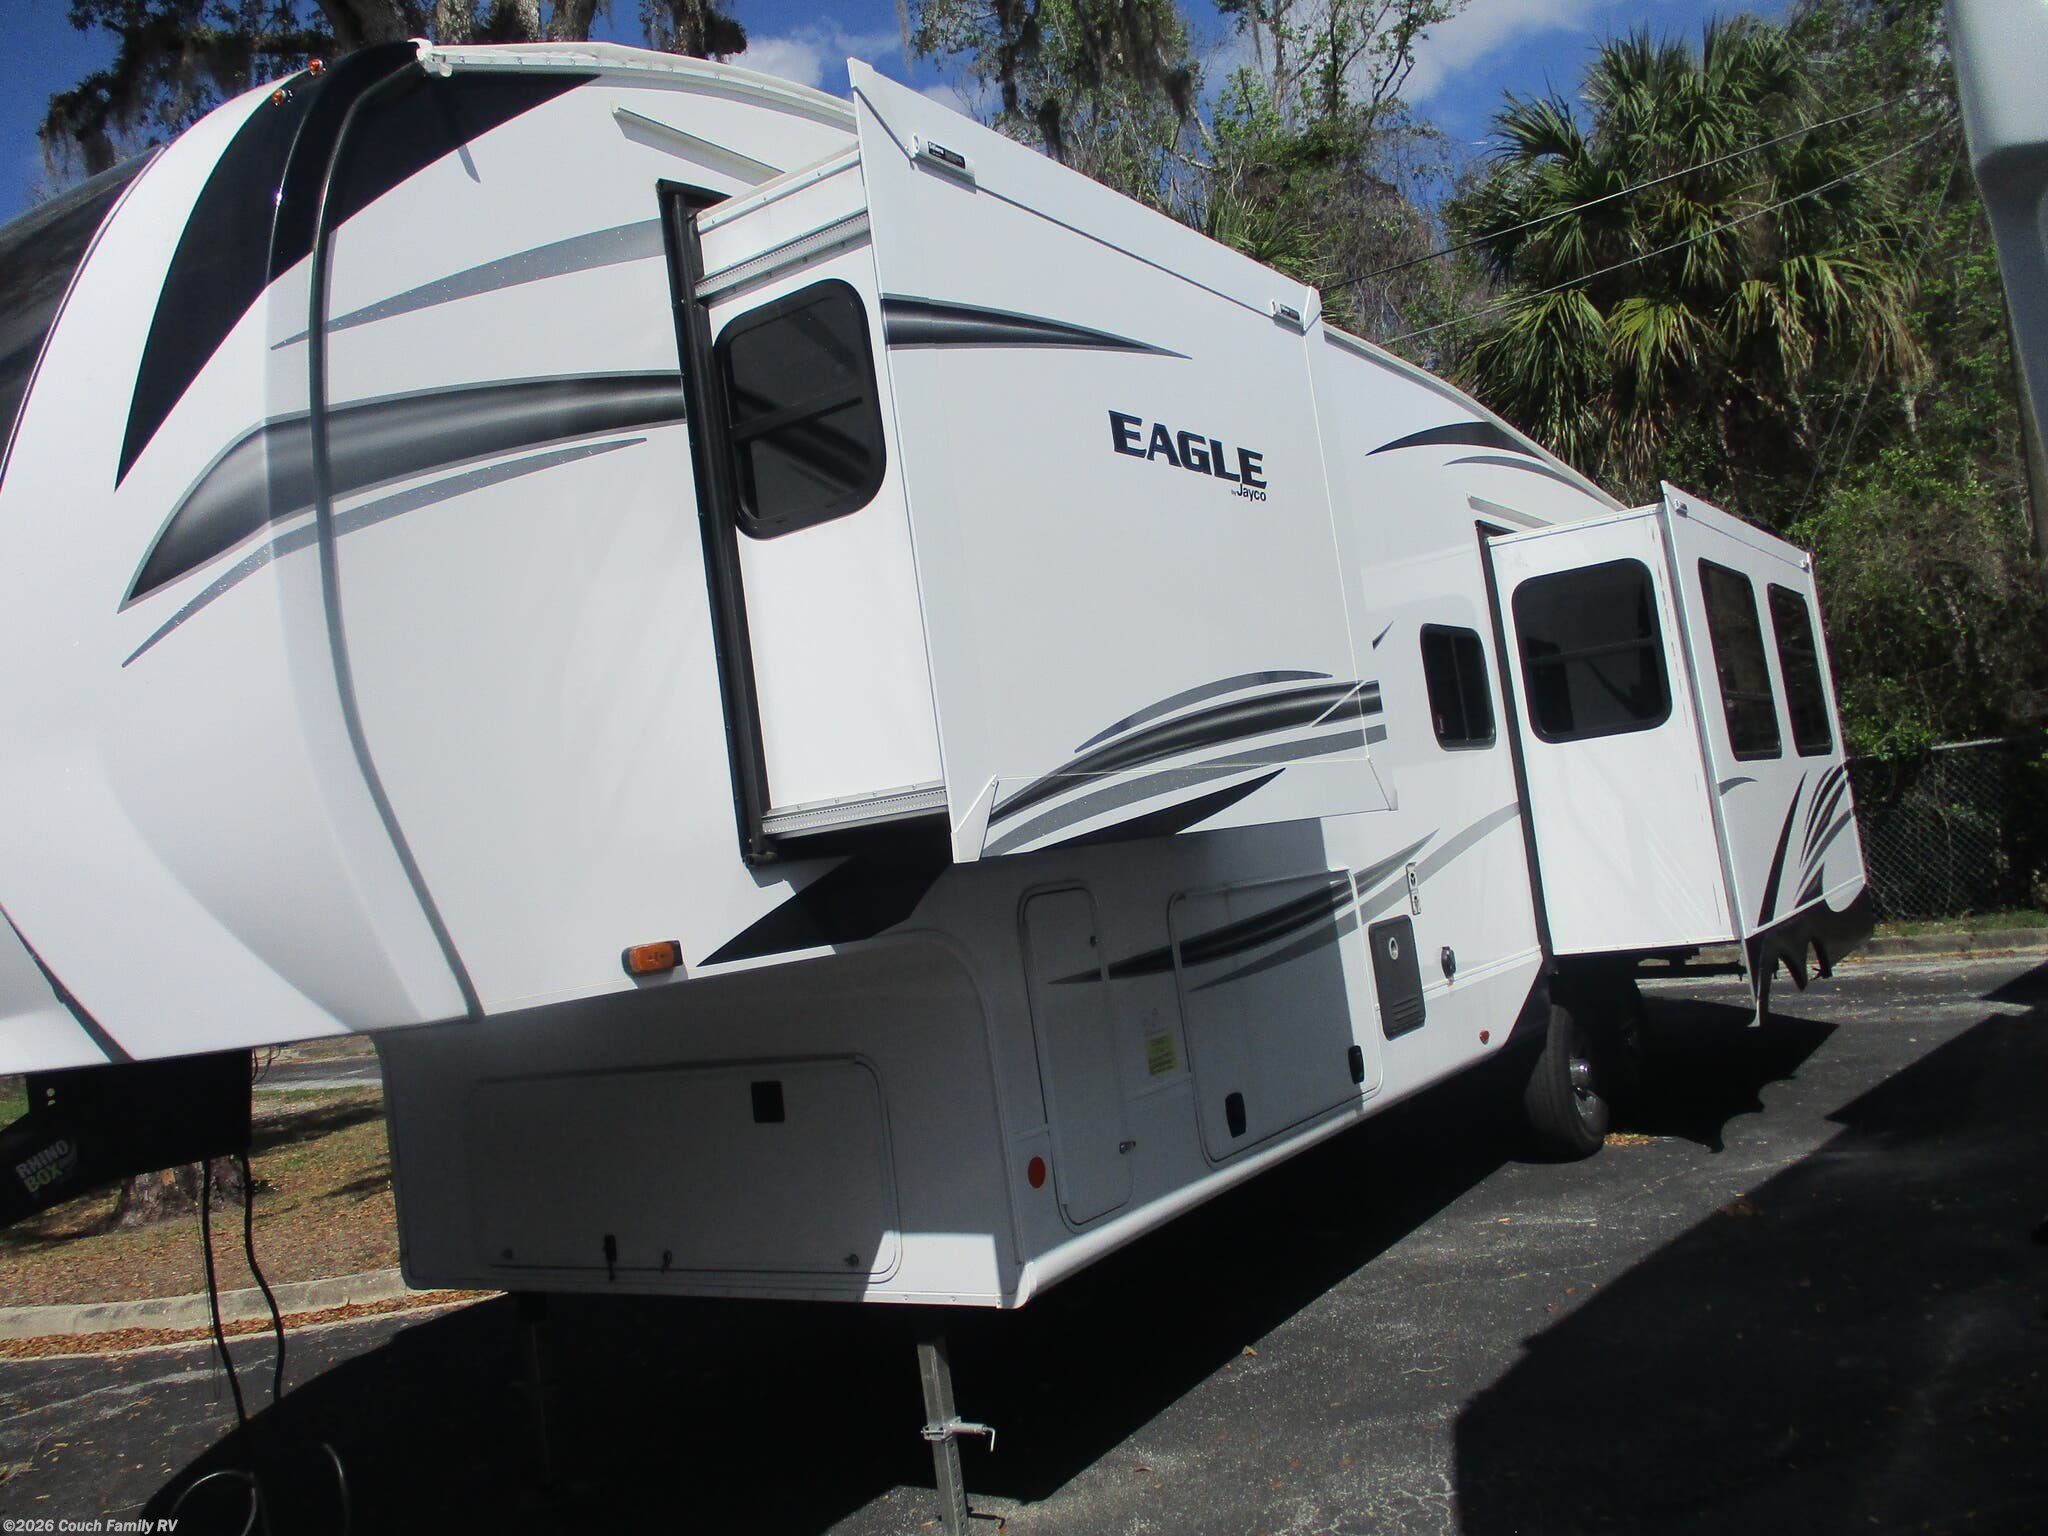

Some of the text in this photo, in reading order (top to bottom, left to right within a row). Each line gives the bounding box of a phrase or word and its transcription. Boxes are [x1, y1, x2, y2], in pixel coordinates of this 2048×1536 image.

[1108, 410, 1267, 489] EAGLE
[1237, 484, 1266, 502] Jayco
[16, 1140, 69, 1178] RHINO
[24, 1159, 63, 1192] BOX
